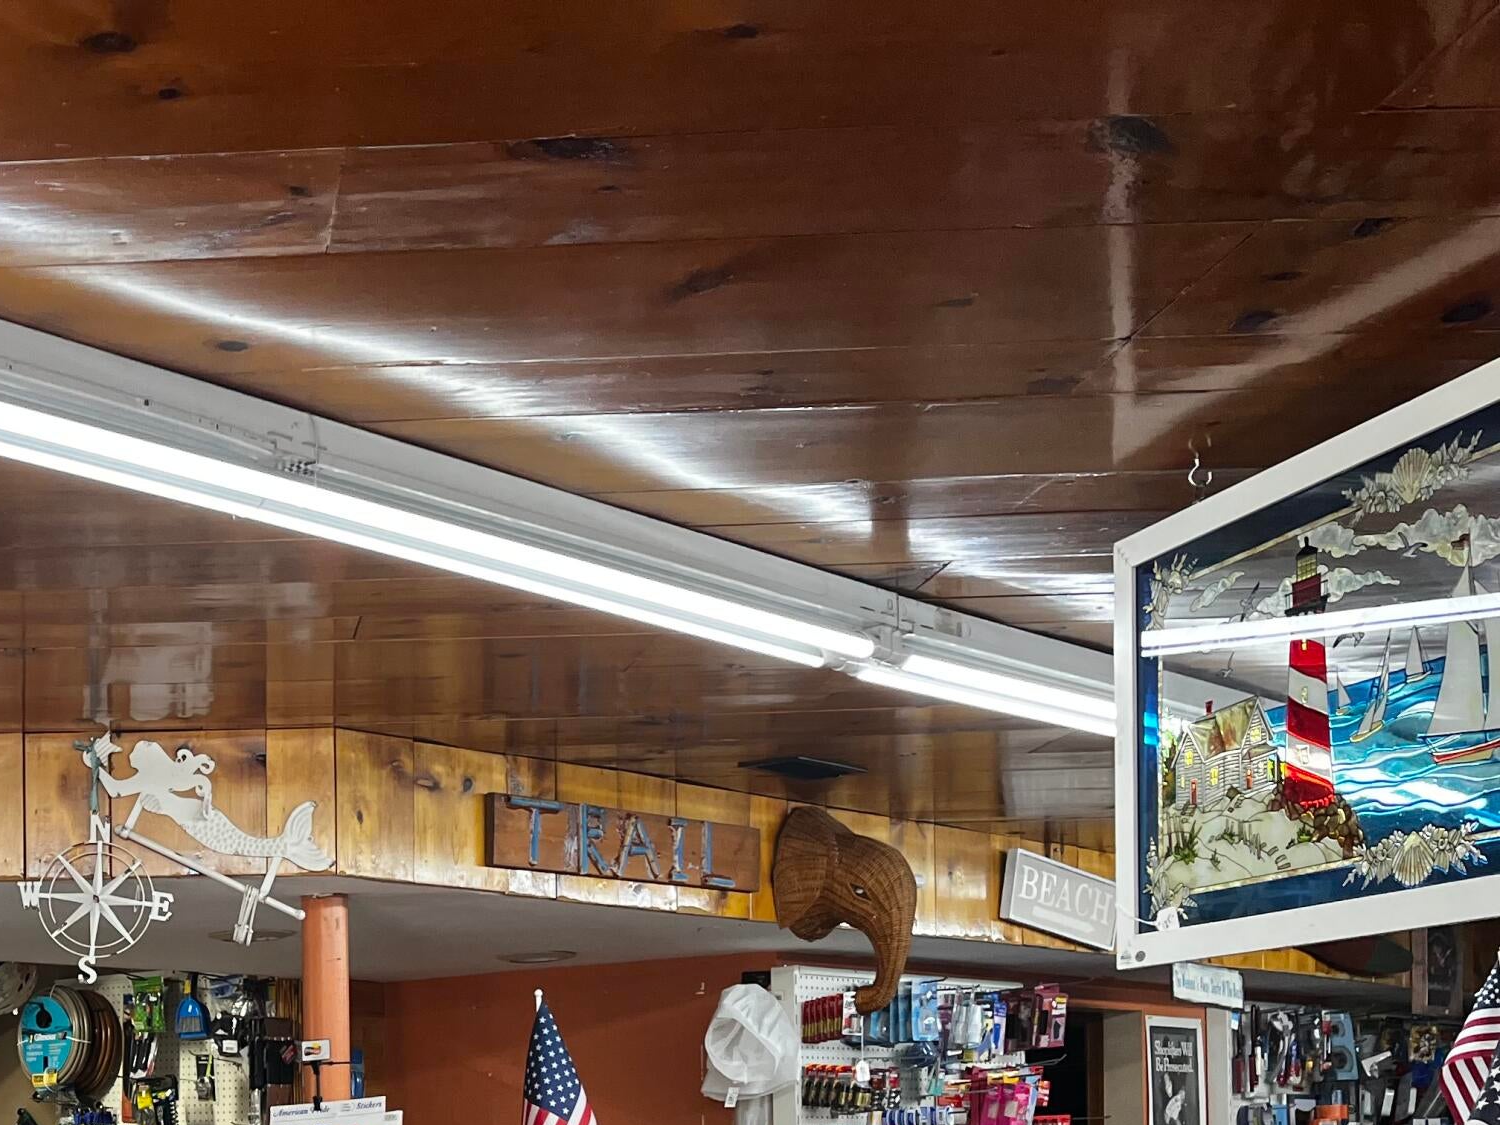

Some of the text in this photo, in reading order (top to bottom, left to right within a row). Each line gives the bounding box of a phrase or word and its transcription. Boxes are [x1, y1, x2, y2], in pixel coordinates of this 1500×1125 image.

[89, 813, 110, 843] N
[507, 795, 736, 888] TRAIL
[17, 881, 42, 909] W
[151, 891, 174, 921] E
[1018, 864, 1114, 926] BEACH
[78, 956, 97, 984] S
[356, 1101, 382, 1110] Stickers
